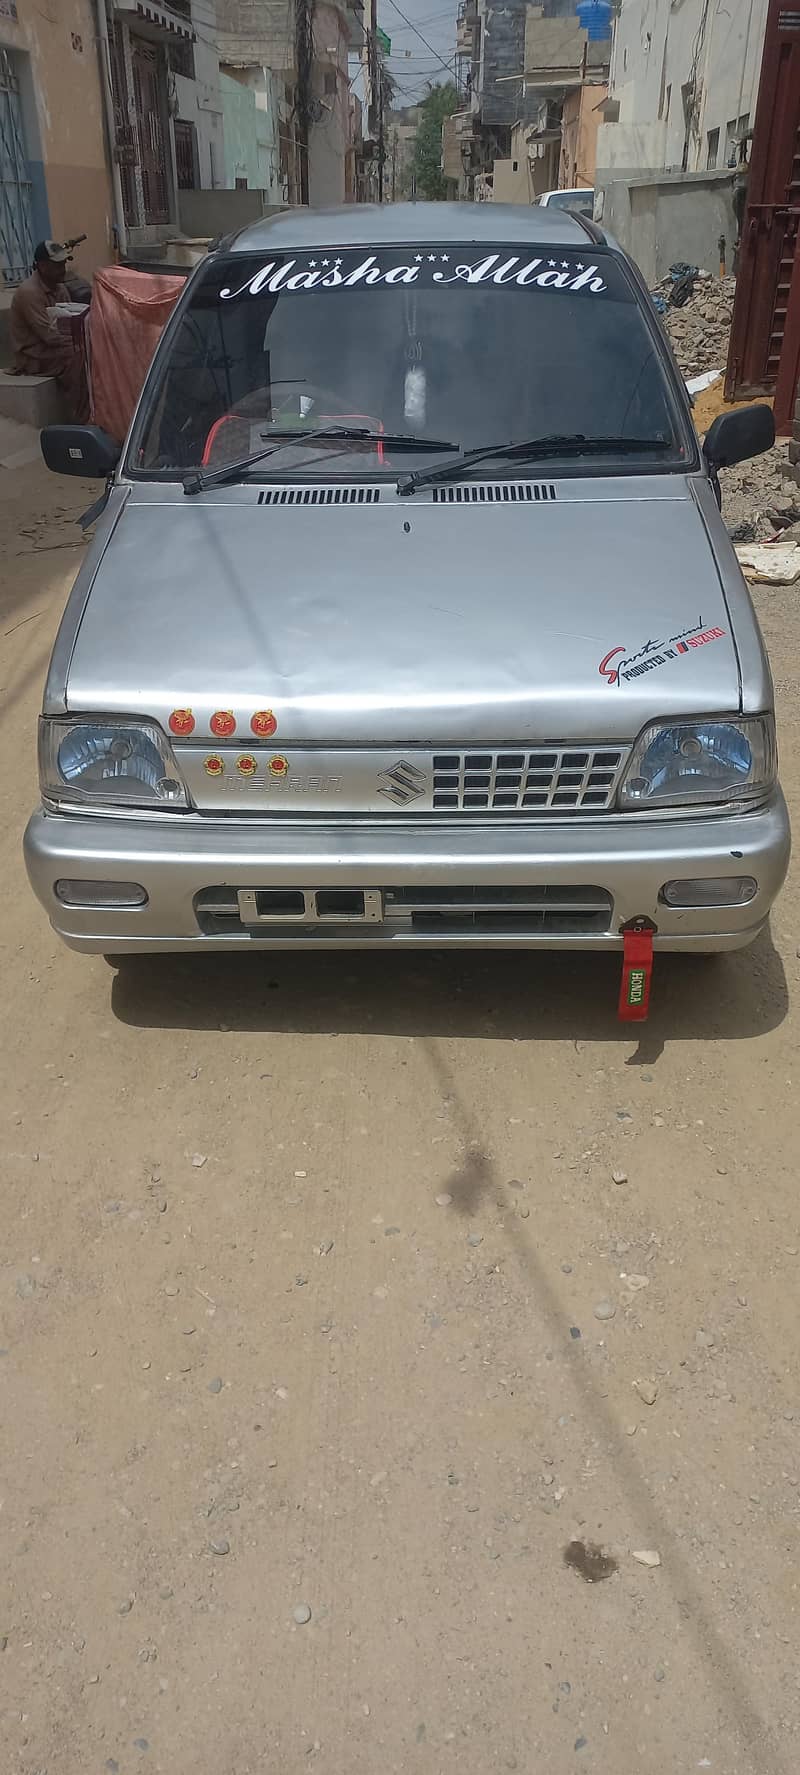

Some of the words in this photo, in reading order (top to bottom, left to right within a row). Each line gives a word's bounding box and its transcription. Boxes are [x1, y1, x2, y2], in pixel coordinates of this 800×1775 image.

[219, 256, 419, 299] Masha
[433, 254, 608, 293] Allah
[598, 640, 665, 687] Sports
[669, 615, 707, 642] mind
[621, 655, 666, 681] PRODUCTED
[663, 649, 678, 659] BY
[686, 627, 726, 648] SUZUKI
[631, 972, 643, 1003] HONDA
